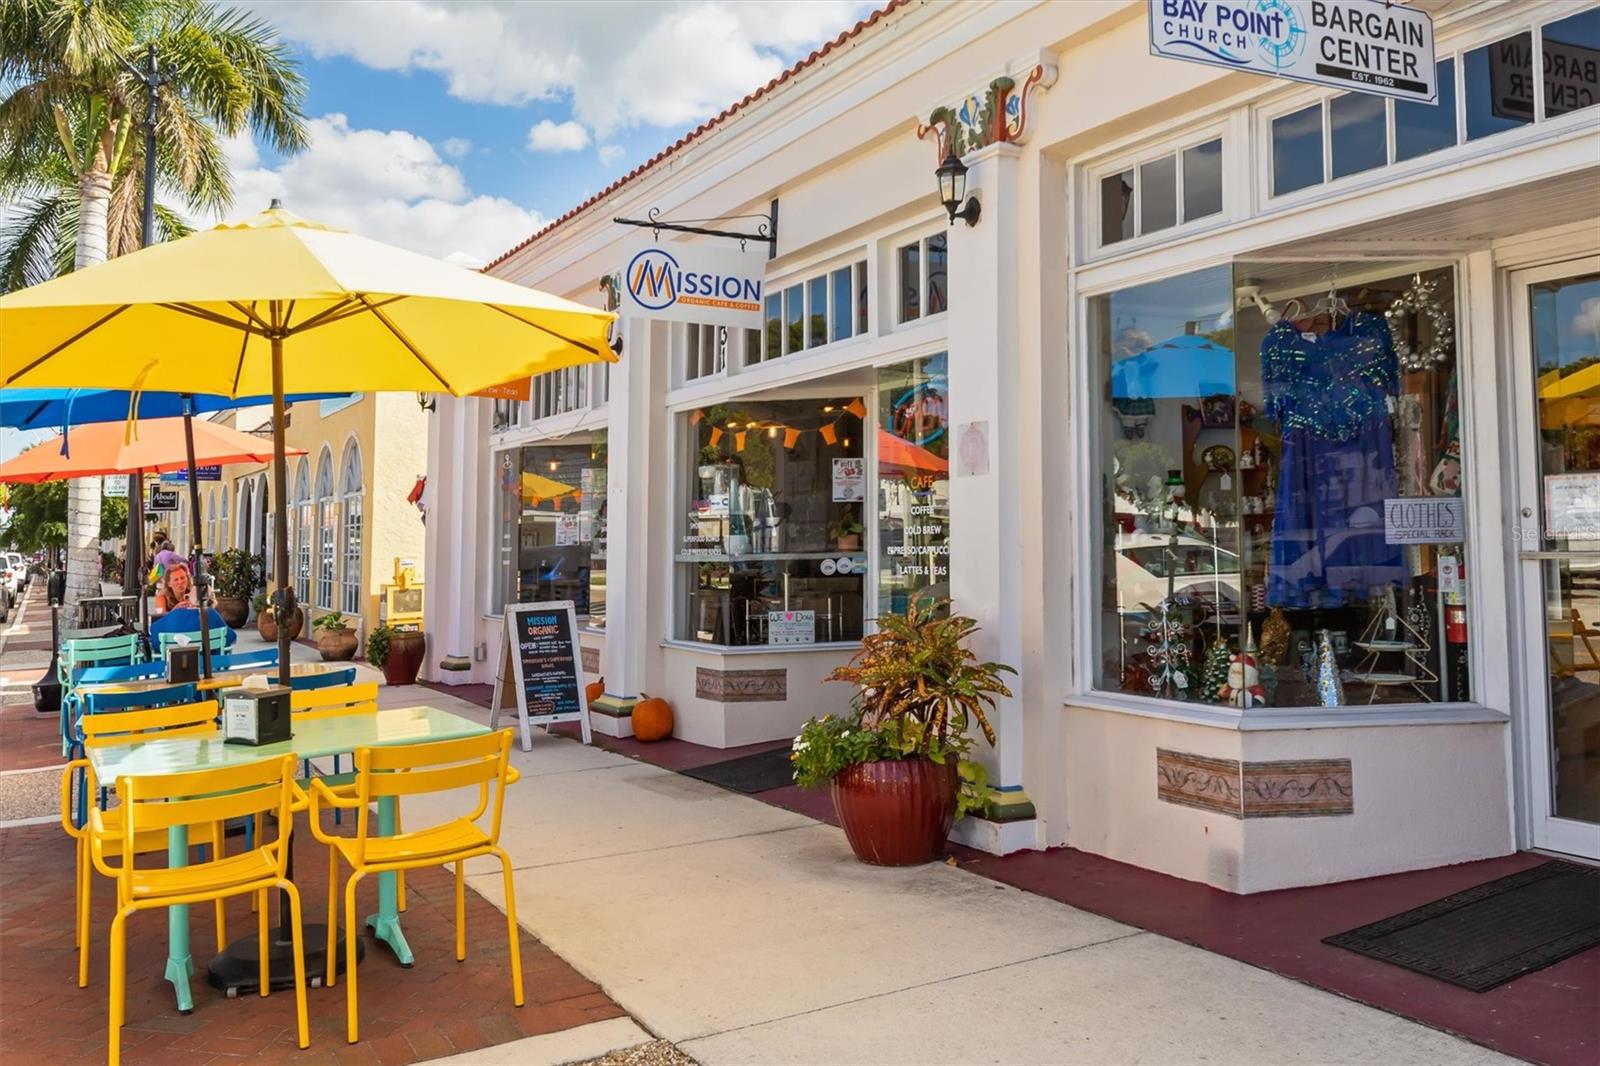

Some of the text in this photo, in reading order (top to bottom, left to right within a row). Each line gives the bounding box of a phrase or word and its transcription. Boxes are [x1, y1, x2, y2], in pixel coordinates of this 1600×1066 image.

[1163, 0, 1208, 23] BAY
[1311, 1, 1424, 48] BARGAIN
[1164, 21, 1247, 49] CHURCH
[1320, 36, 1419, 78] CENTER
[1351, 71, 1395, 87] EST. 1962
[631, 256, 761, 302] MISSION
[910, 505, 935, 515] COFFEE
[1391, 502, 1456, 529] CLOTHES
[904, 524, 942, 535] COLD BREW
[1394, 529, 1456, 539] SPECIAL RACK
[899, 566, 923, 576] LATTES
[528, 616, 557, 626] MISSION
[527, 625, 560, 636] ORGANIC
